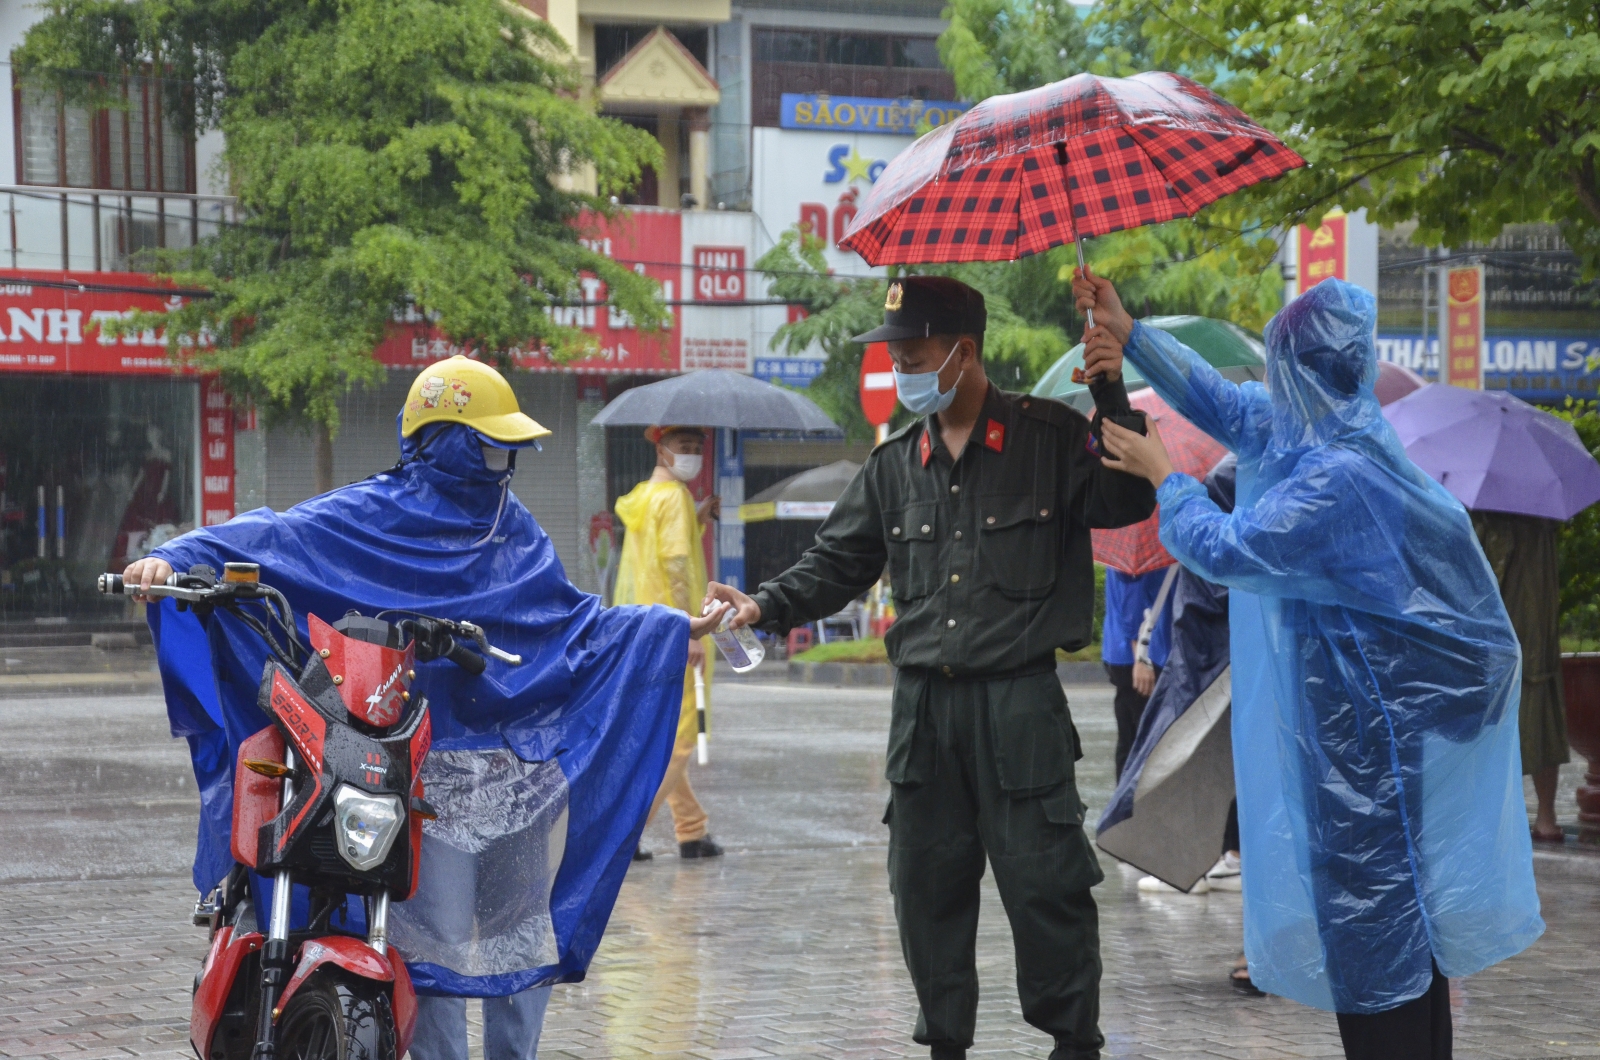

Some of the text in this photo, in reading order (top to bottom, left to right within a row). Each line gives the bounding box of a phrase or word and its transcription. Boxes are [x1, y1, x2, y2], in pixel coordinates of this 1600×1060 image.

[700, 252, 738, 271] UNI
[699, 274, 741, 299] QLO
[1483, 339, 1557, 372] LOAN
[272, 693, 318, 743] SPORT
[359, 762, 388, 774] X-MEN
